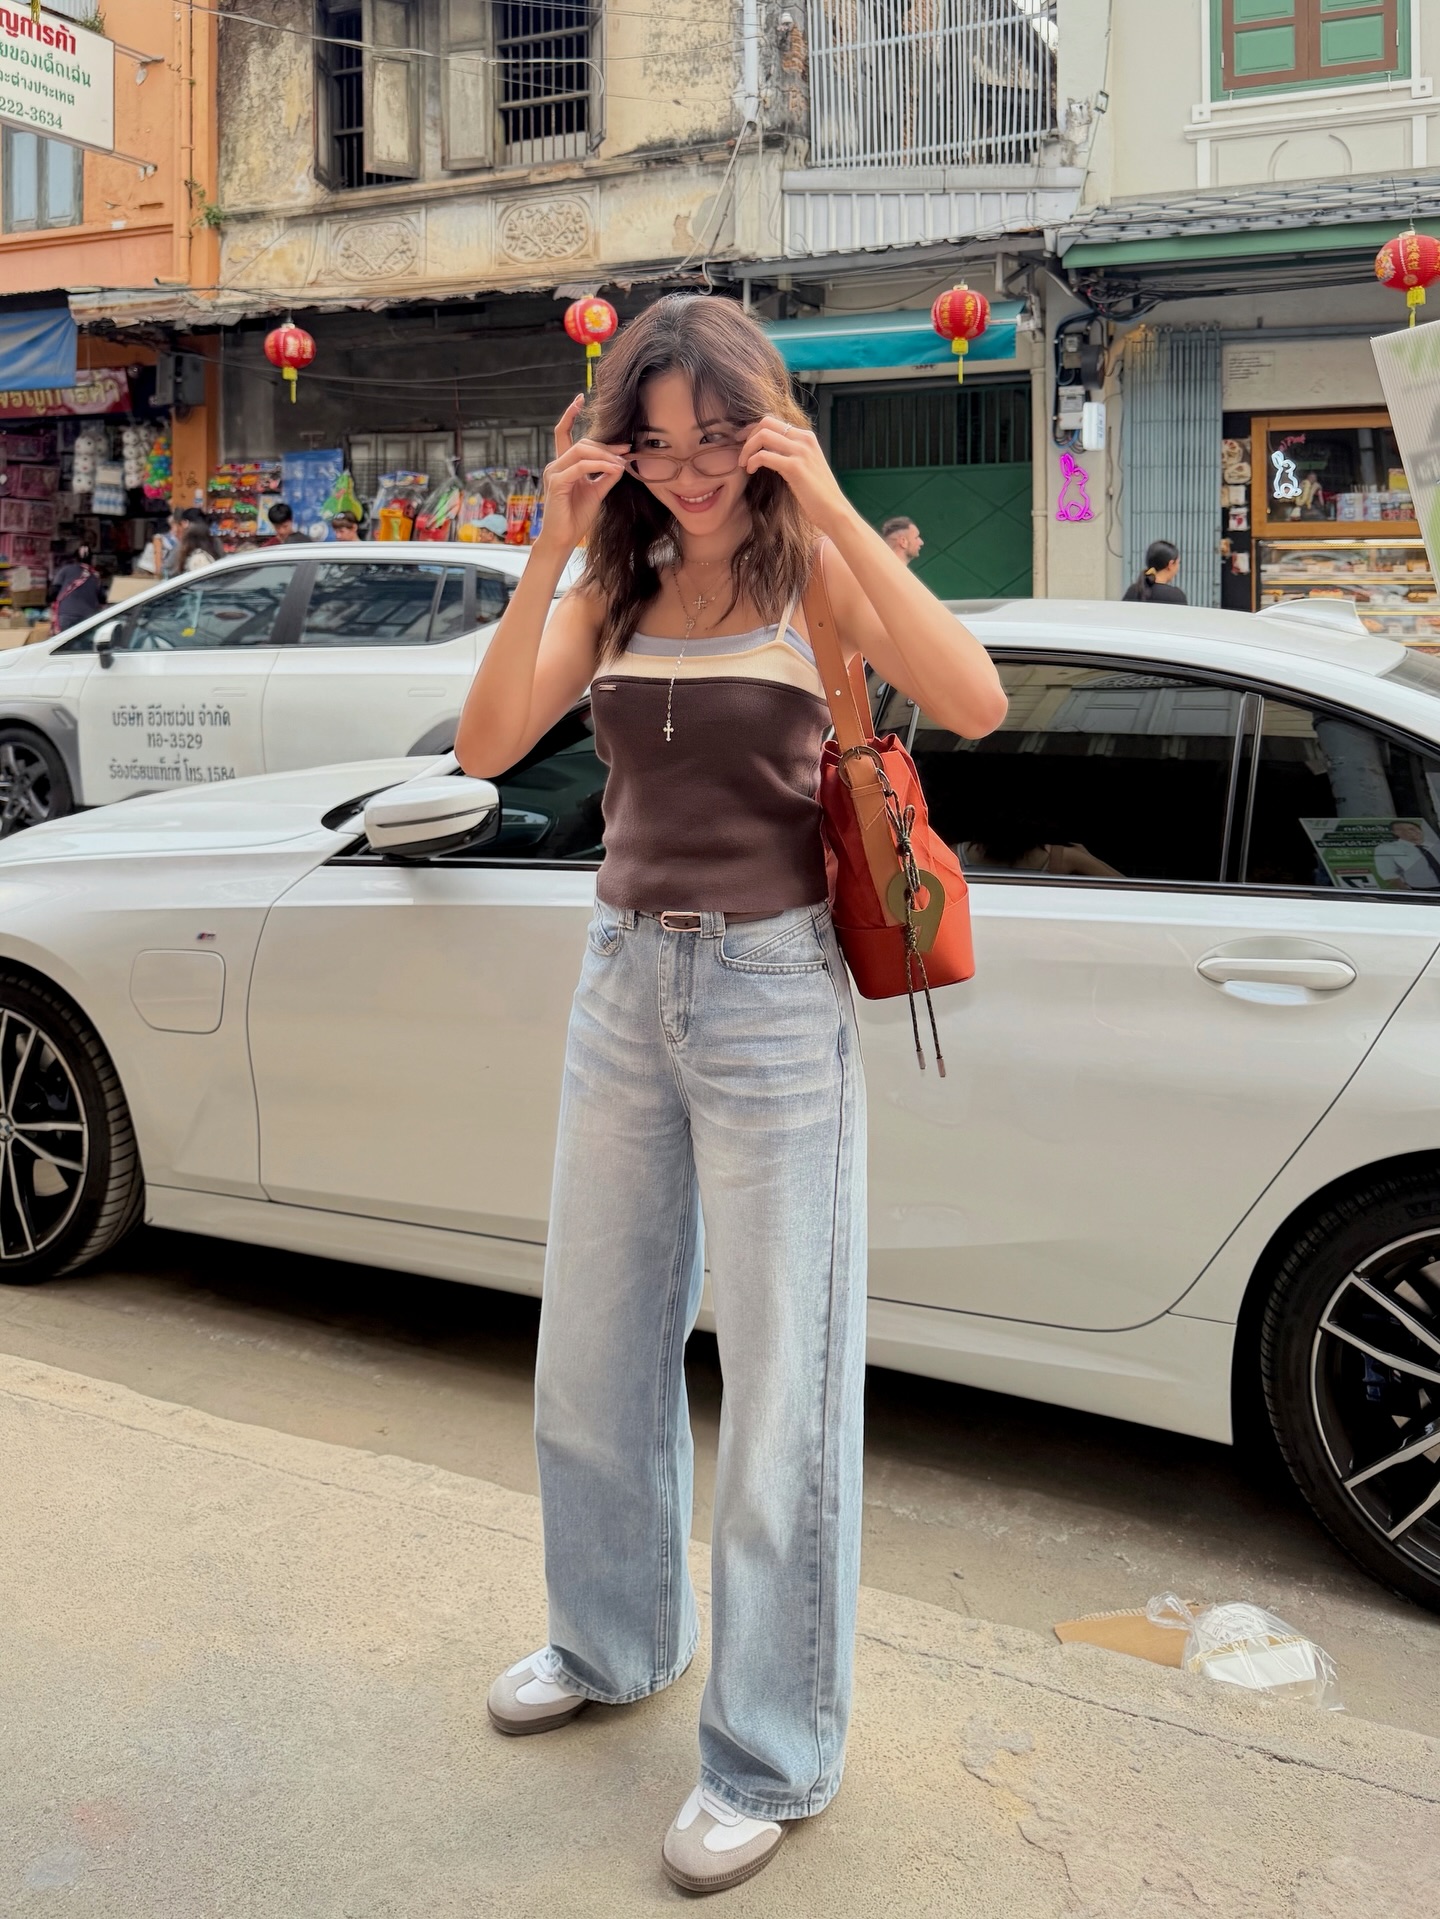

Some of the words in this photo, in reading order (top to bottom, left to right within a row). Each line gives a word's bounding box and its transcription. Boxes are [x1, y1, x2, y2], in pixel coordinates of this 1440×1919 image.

[112, 705, 144, 727] บริษัท
[199, 704, 231, 727] จำกัด
